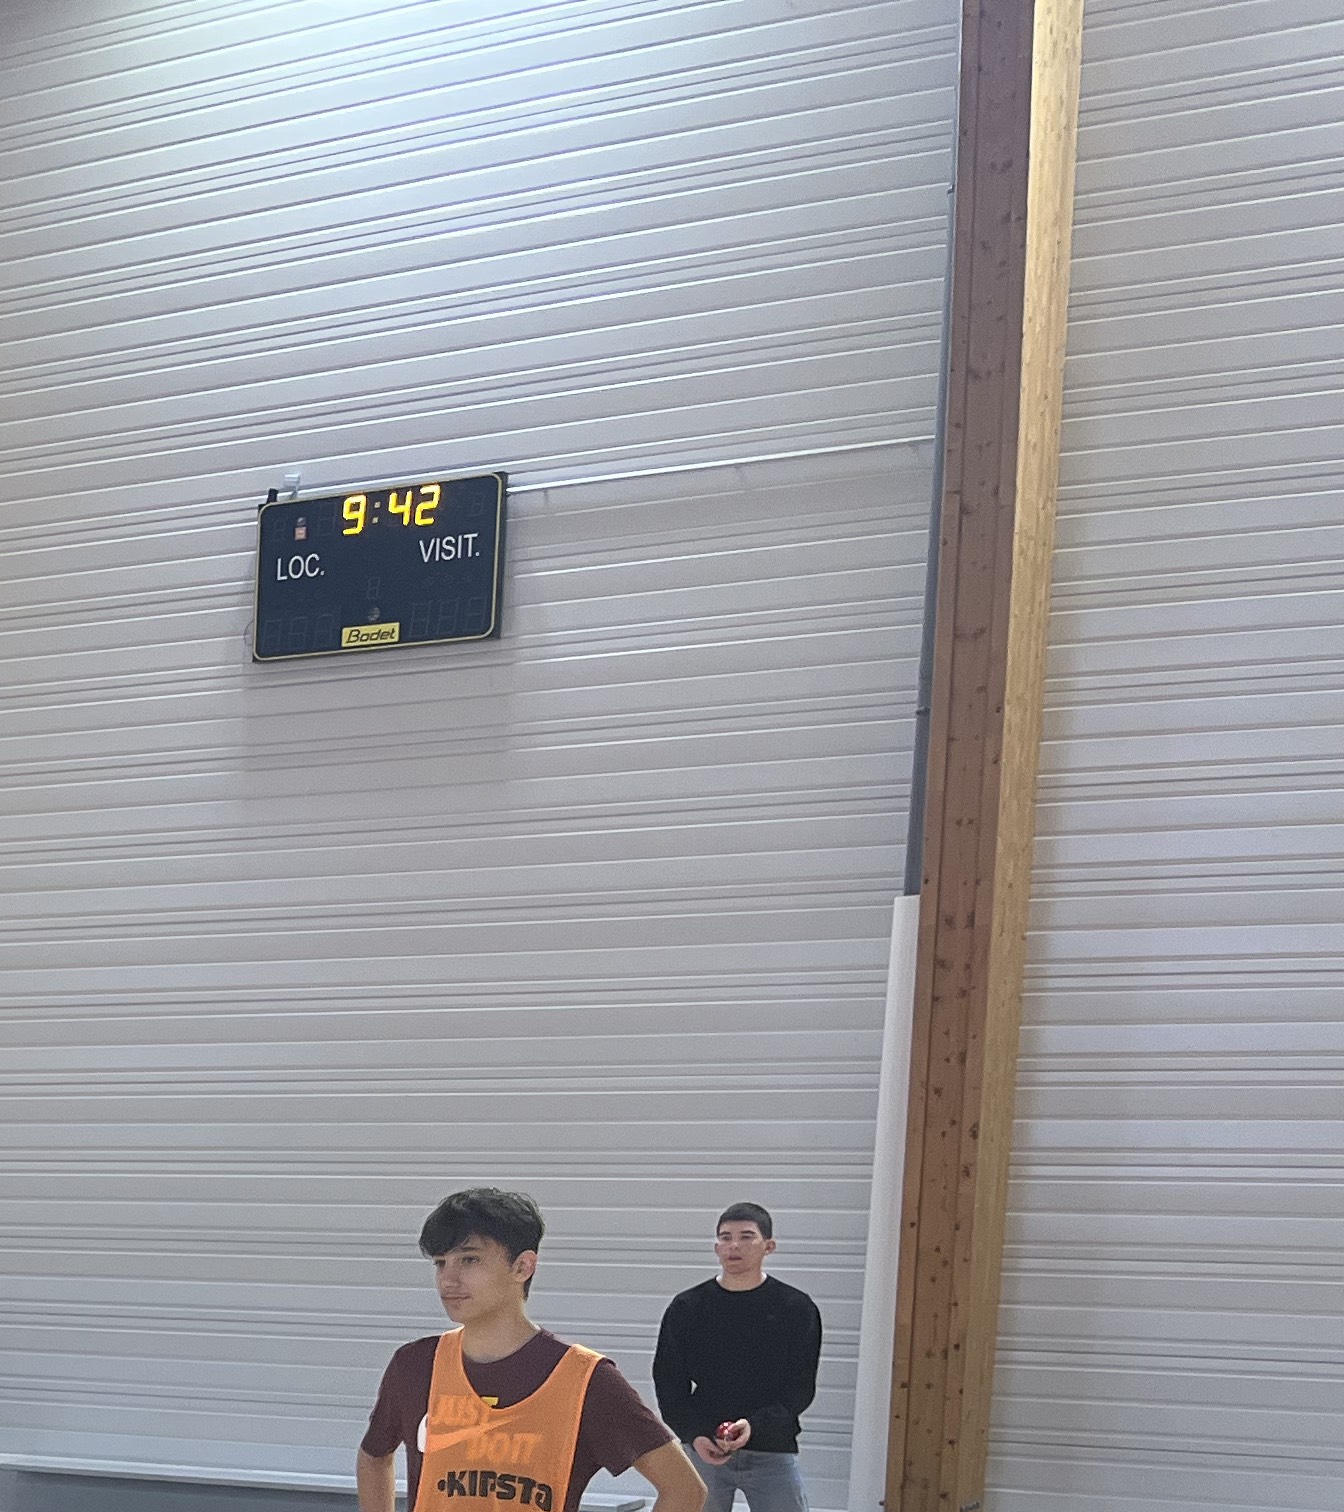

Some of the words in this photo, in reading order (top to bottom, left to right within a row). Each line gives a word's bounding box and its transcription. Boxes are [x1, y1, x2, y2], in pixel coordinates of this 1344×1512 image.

[342, 484, 441, 536] 9:42
[419, 532, 481, 563] VISIT.
[276, 553, 325, 581] LOC.
[346, 627, 396, 644] Bodet
